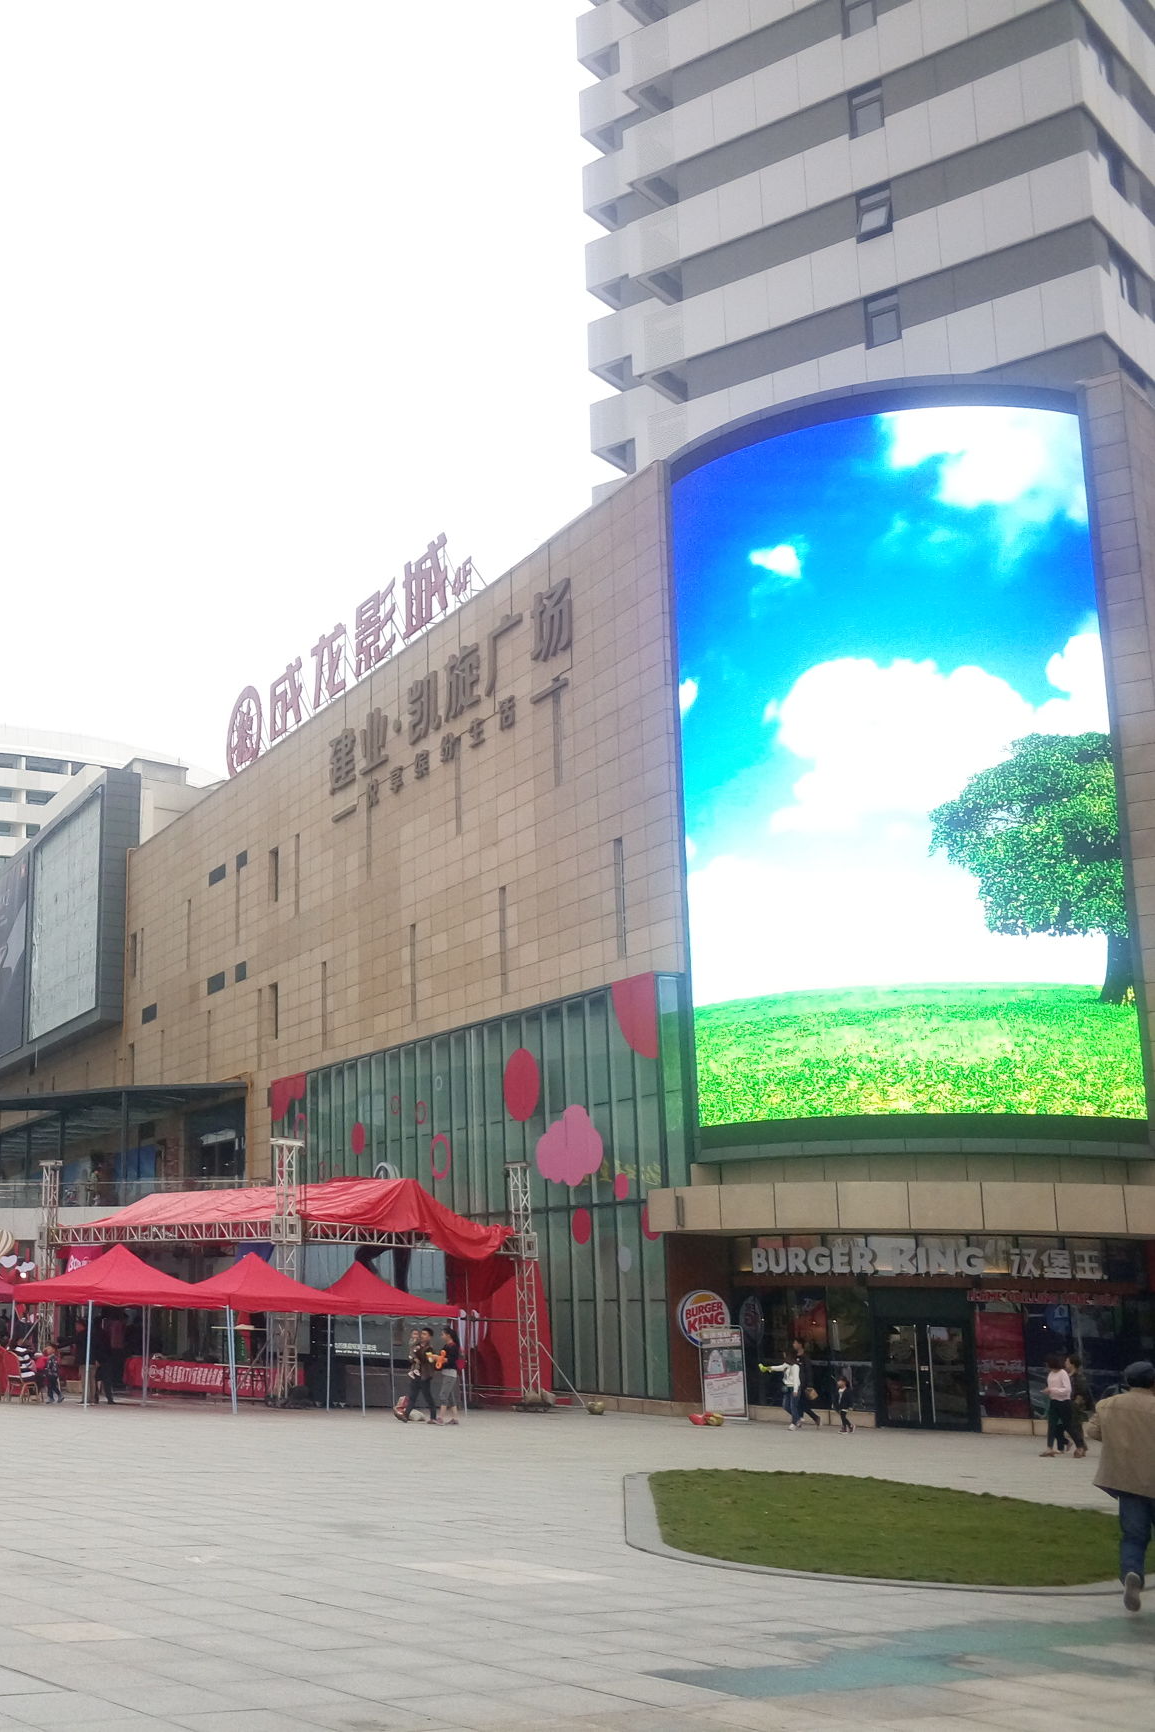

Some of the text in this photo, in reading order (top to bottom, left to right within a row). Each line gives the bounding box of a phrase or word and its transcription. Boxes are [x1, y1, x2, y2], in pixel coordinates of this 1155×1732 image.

[270, 532, 447, 742] 成龙影城
[752, 1246, 985, 1276] BURGER KING
[1010, 1248, 1104, 1280] 汉堡王
[686, 1301, 723, 1320] BURGER
[687, 1311, 725, 1334] KING
